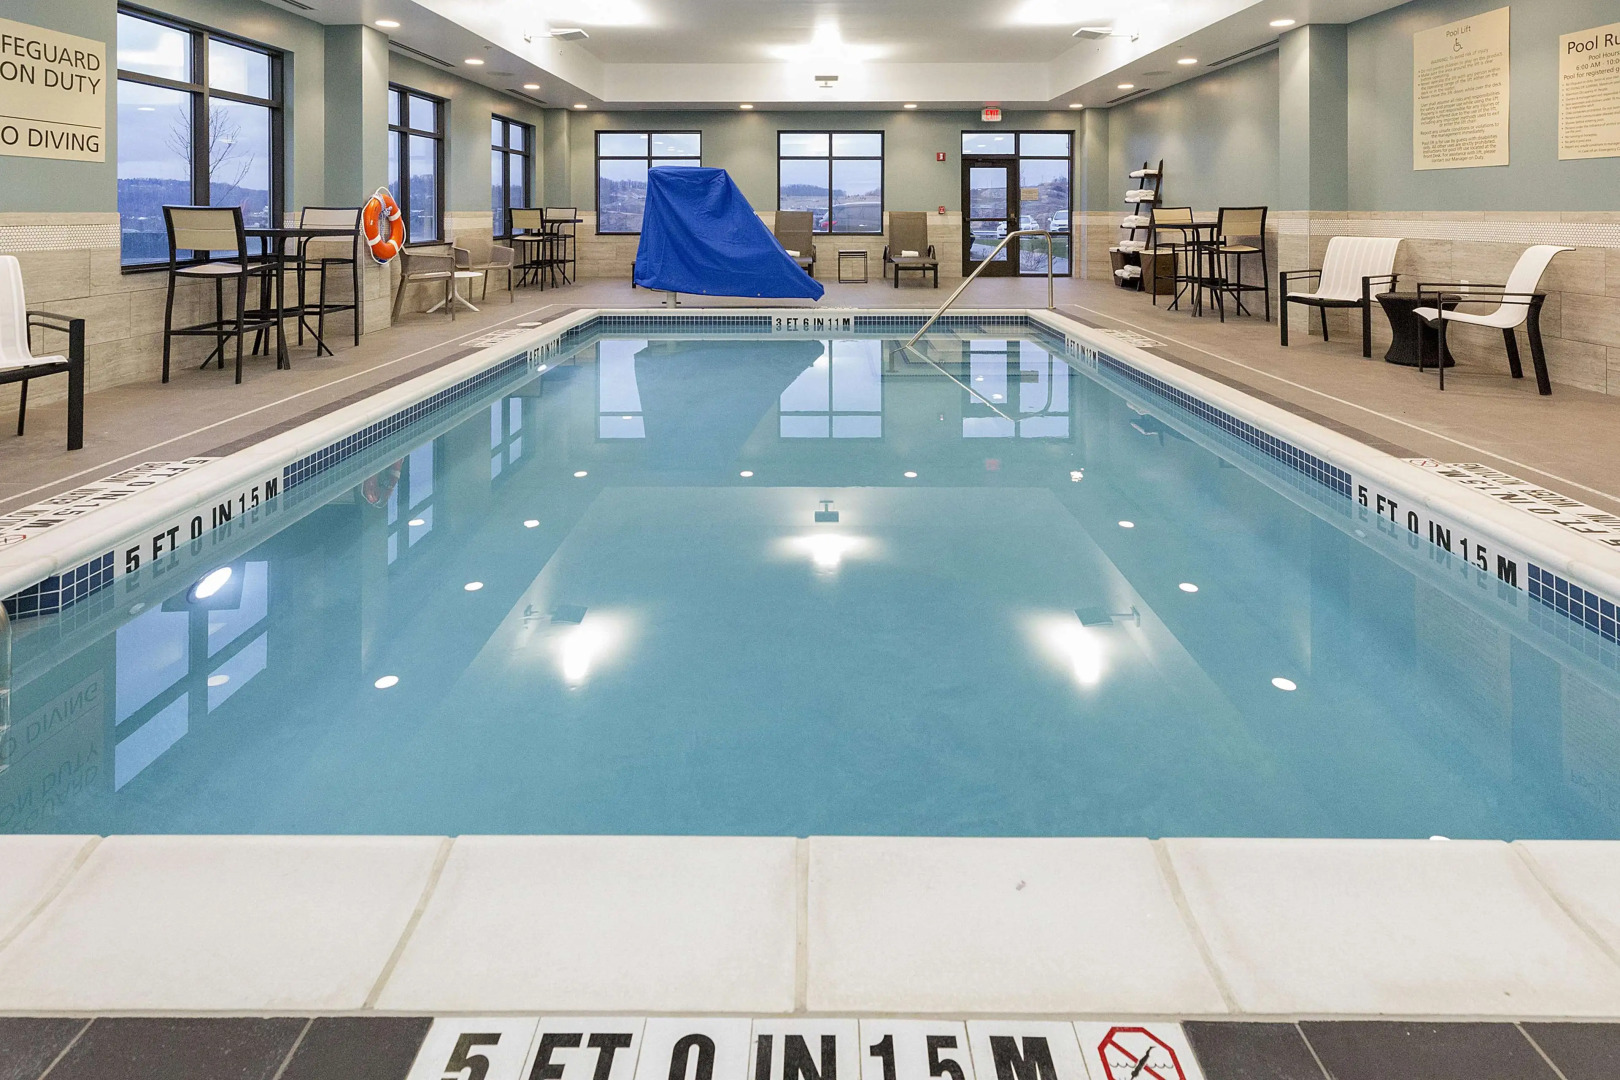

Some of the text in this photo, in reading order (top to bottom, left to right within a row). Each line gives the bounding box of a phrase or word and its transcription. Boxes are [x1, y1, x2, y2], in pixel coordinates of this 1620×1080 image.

[1446, 25, 1471, 37] Pool Lift
[1, 34, 100, 72] FEGUARD
[1568, 35, 1598, 54] Pool
[0, 61, 100, 94] ON DUTY
[1586, 67, 1614, 77] registered
[28, 128, 100, 153] DIVING
[1358, 484, 1368, 508] 5
[126, 544, 140, 574] 5
[755, 1034, 836, 1080] IN
[989, 1036, 1058, 1080] M
